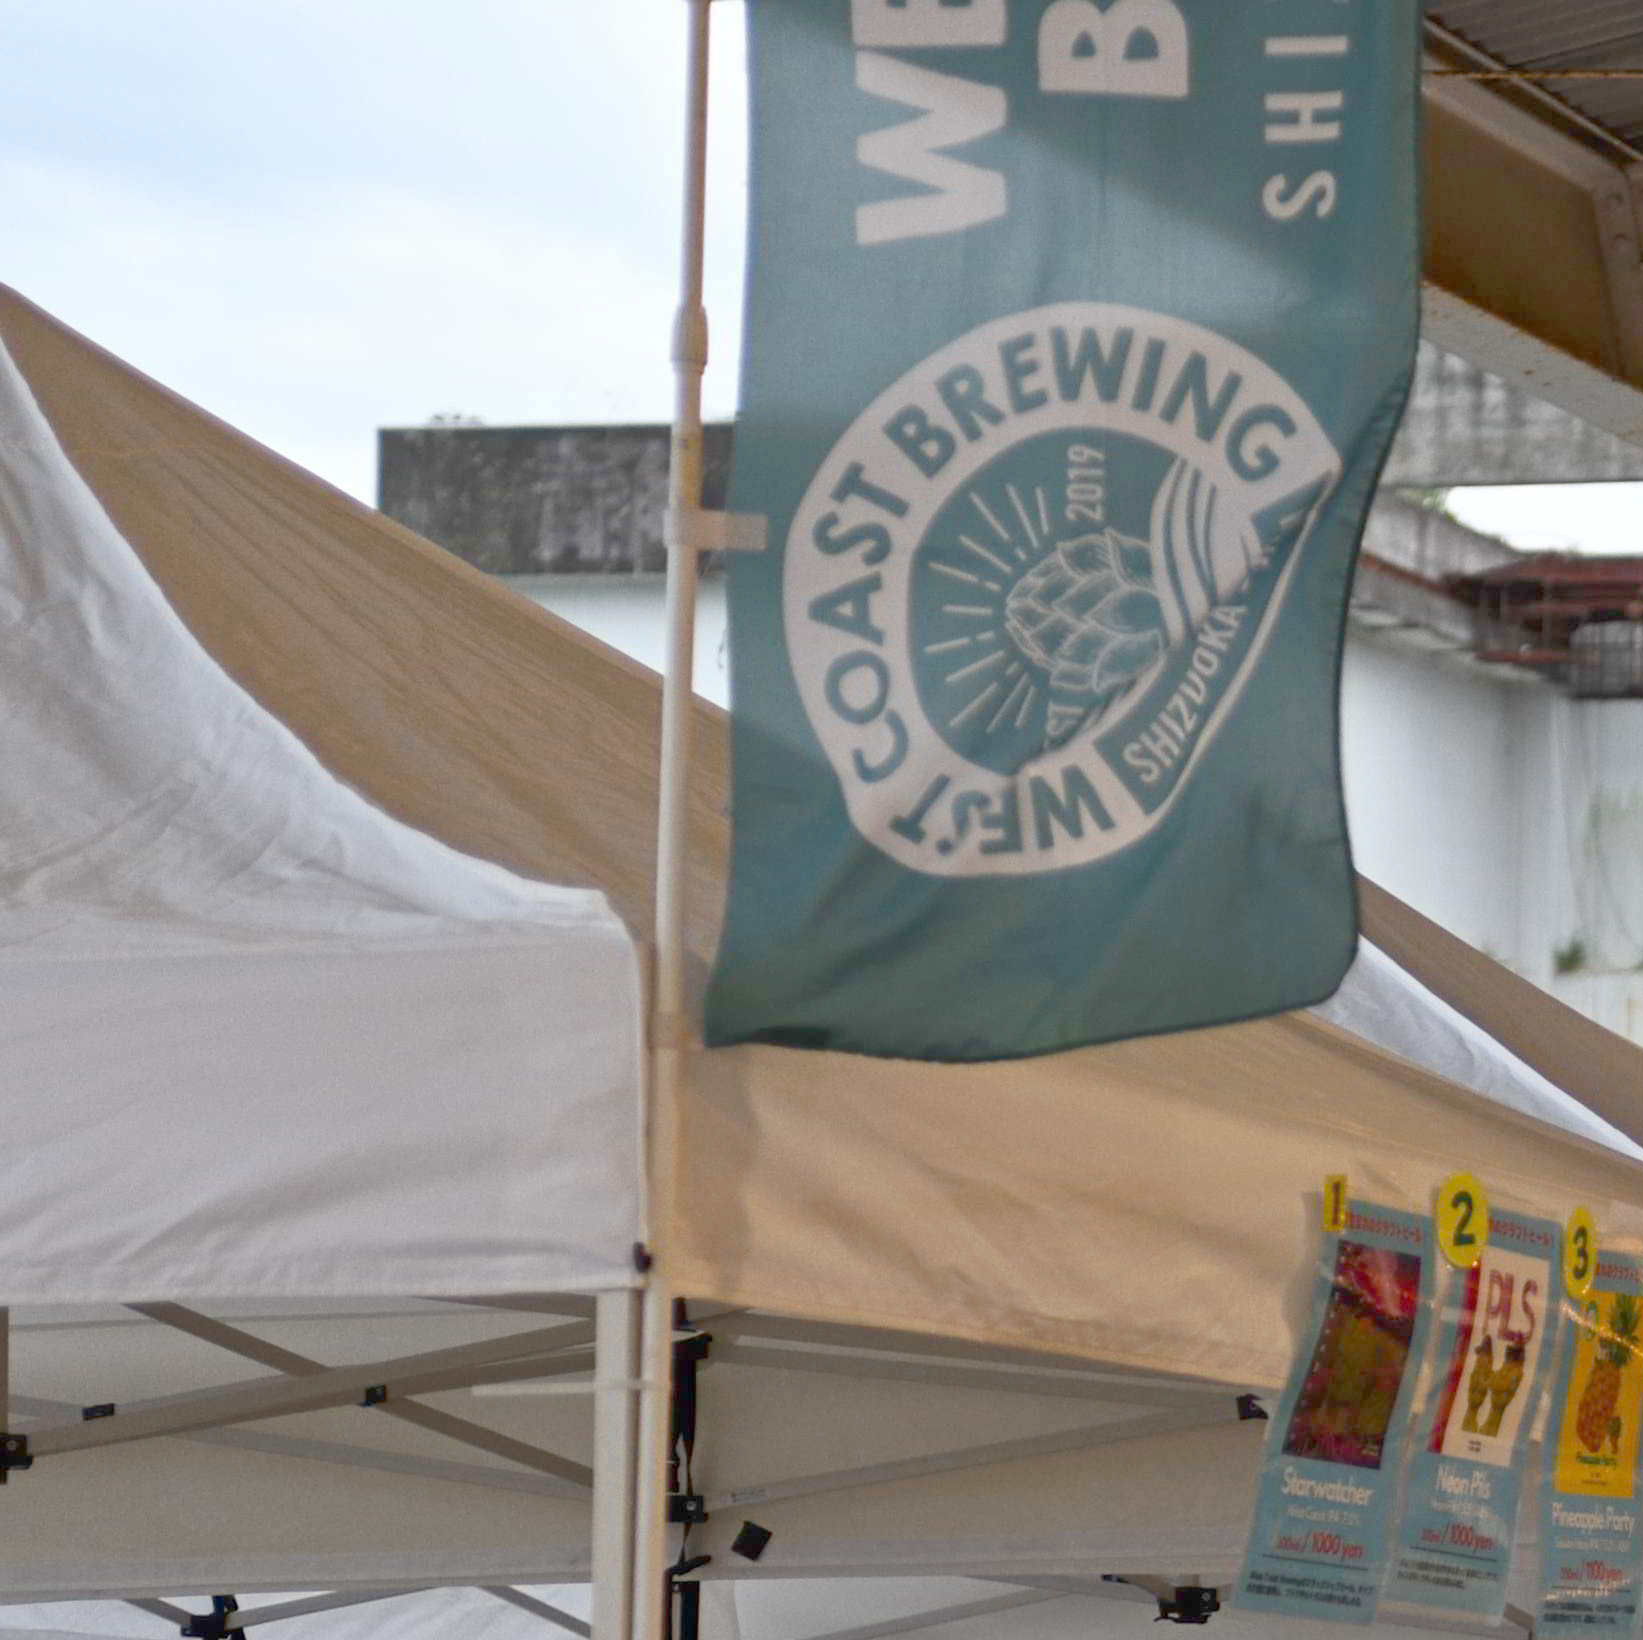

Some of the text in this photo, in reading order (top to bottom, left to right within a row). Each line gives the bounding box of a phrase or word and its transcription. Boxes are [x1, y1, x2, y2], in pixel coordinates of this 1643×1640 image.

[1066, 444, 1106, 522] 2019
[807, 326, 1298, 857] WEST COAST BREWING
[1122, 601, 1248, 784] SHIZUOKA
[1331, 1180, 1341, 1226] 1
[1451, 1189, 1476, 1247] 2
[1572, 1225, 1589, 1281] 3
[1281, 1466, 1376, 1506] Starwatcher
